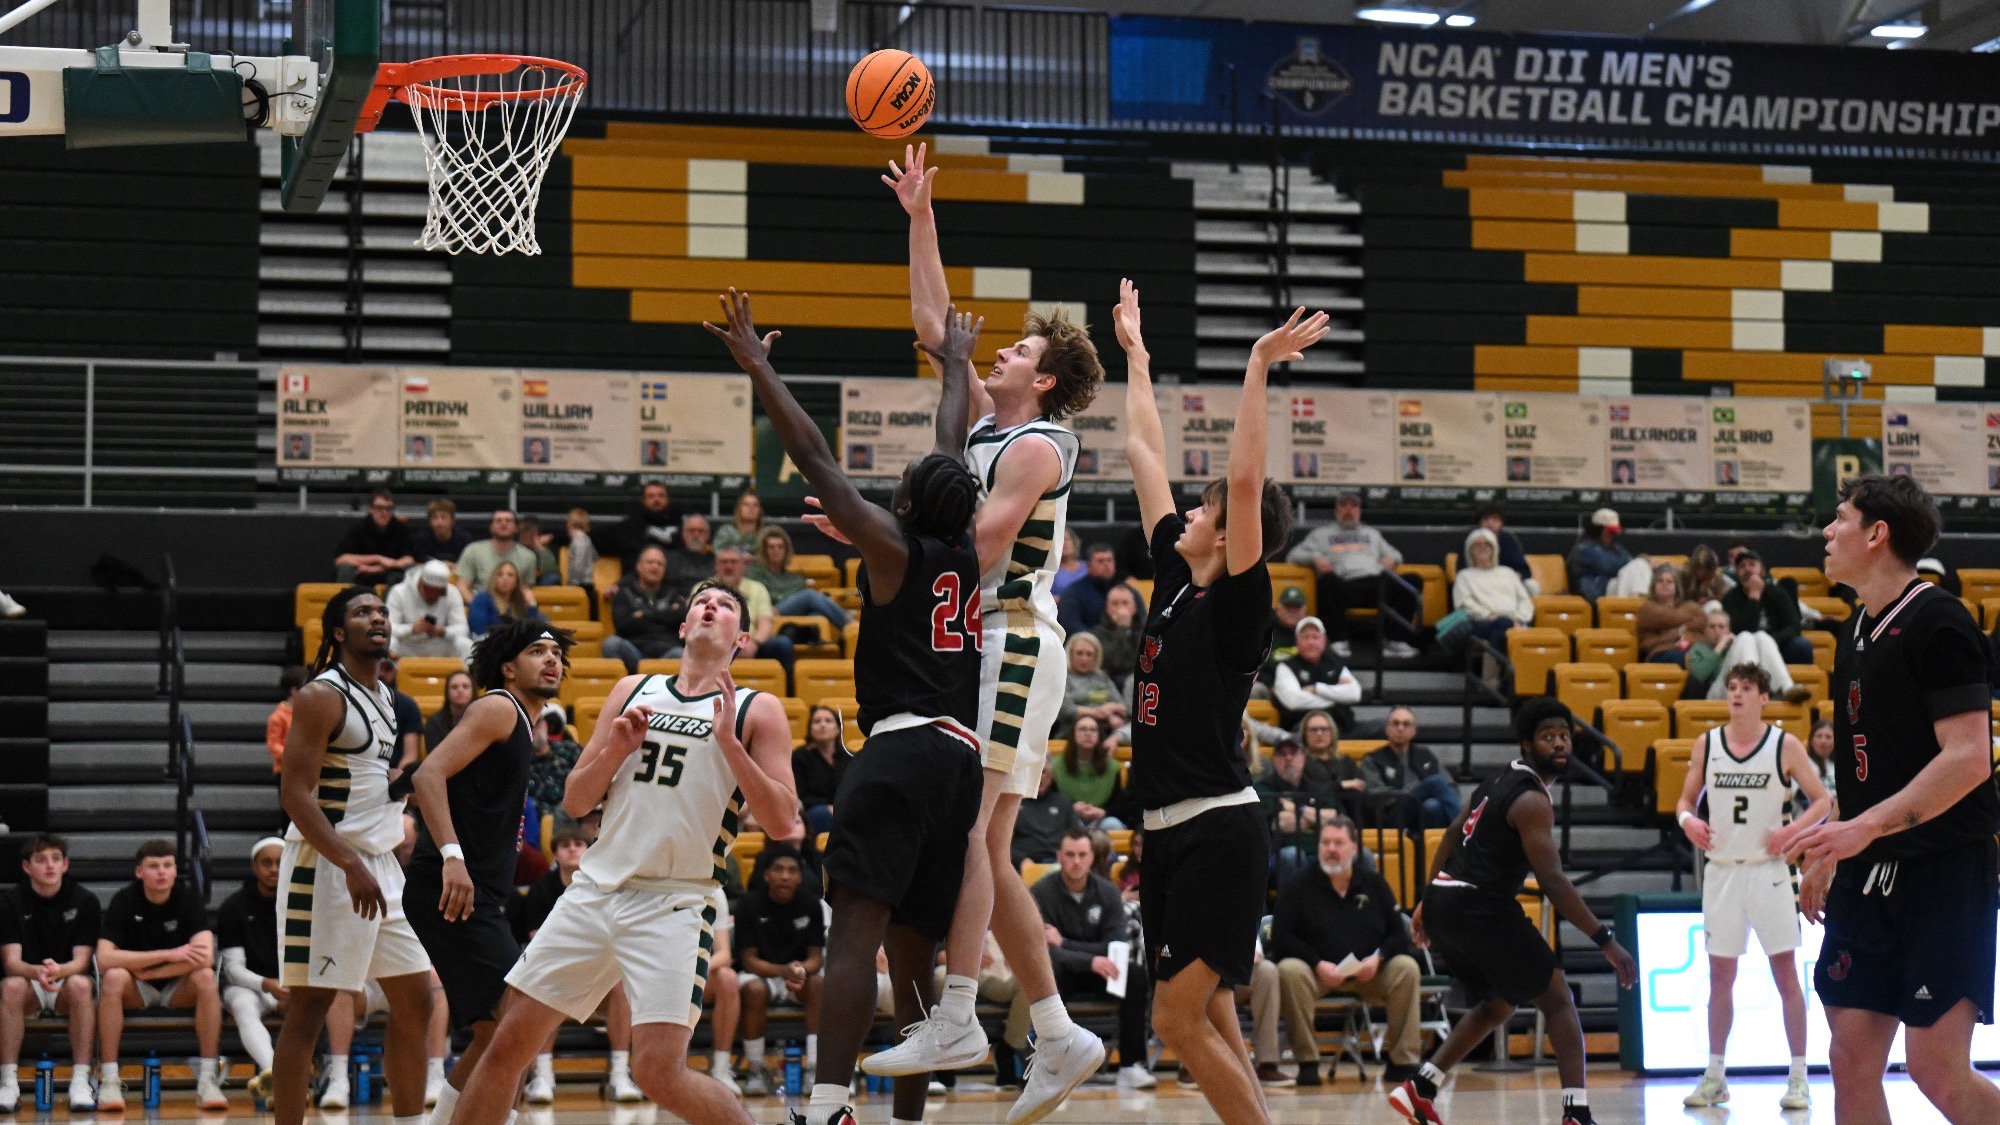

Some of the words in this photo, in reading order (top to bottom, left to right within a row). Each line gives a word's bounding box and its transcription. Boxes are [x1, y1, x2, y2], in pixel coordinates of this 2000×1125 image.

[1377, 41, 1497, 80] NCAA
[1514, 46, 1590, 84] DII
[1600, 50, 1734, 90] MEN'S
[890, 71, 921, 110] NCAA
[1378, 81, 1652, 125] BASKETBALL
[1664, 92, 2000, 137] CHAMPIONSHIP
[283, 399, 327, 414] ALEX
[405, 400, 469, 416] PATRYK
[523, 404, 593, 419] WILLIAM
[641, 405, 656, 421] LI
[1610, 427, 1697, 443] ALEXANDER
[1714, 429, 1773, 444] JULIANO
[1887, 432, 1920, 446] LIAM
[931, 571, 983, 652] 24
[1138, 681, 1160, 726] 12
[647, 711, 713, 737] INERS
[634, 740, 688, 787] 35
[1852, 734, 1868, 782] 5
[1716, 774, 1768, 789] MINERS
[1733, 796, 1749, 824] 2
